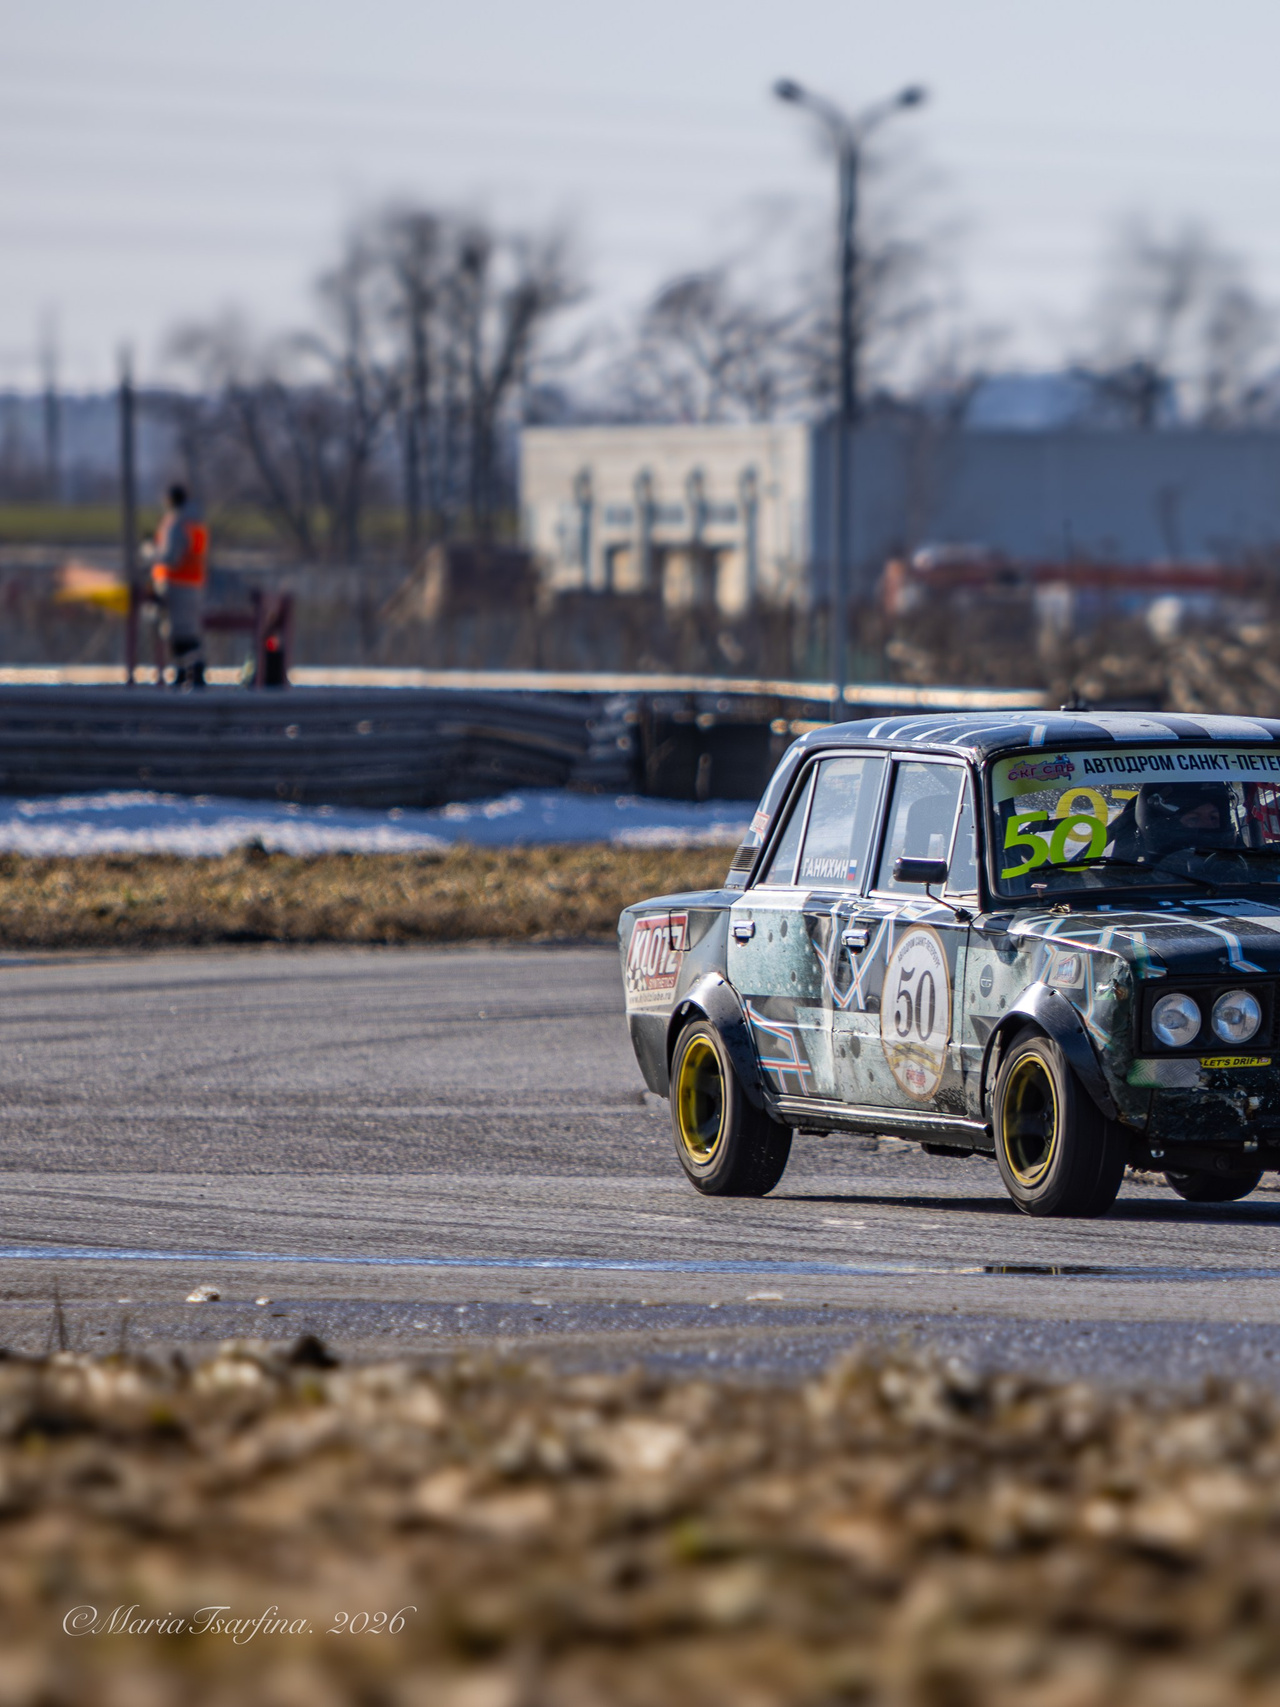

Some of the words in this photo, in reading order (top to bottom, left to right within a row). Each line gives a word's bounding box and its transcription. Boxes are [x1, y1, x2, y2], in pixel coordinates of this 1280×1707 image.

[1083, 754, 1174, 774] АВТОДРОМ
[1001, 810, 1108, 879] 50
[802, 858, 849, 879] ГАНИХИН
[629, 925, 684, 978] KLOTZ
[894, 966, 936, 1042] 50
[1203, 1058, 1231, 1067] LET'S
[1233, 1057, 1261, 1066] DRIFT
